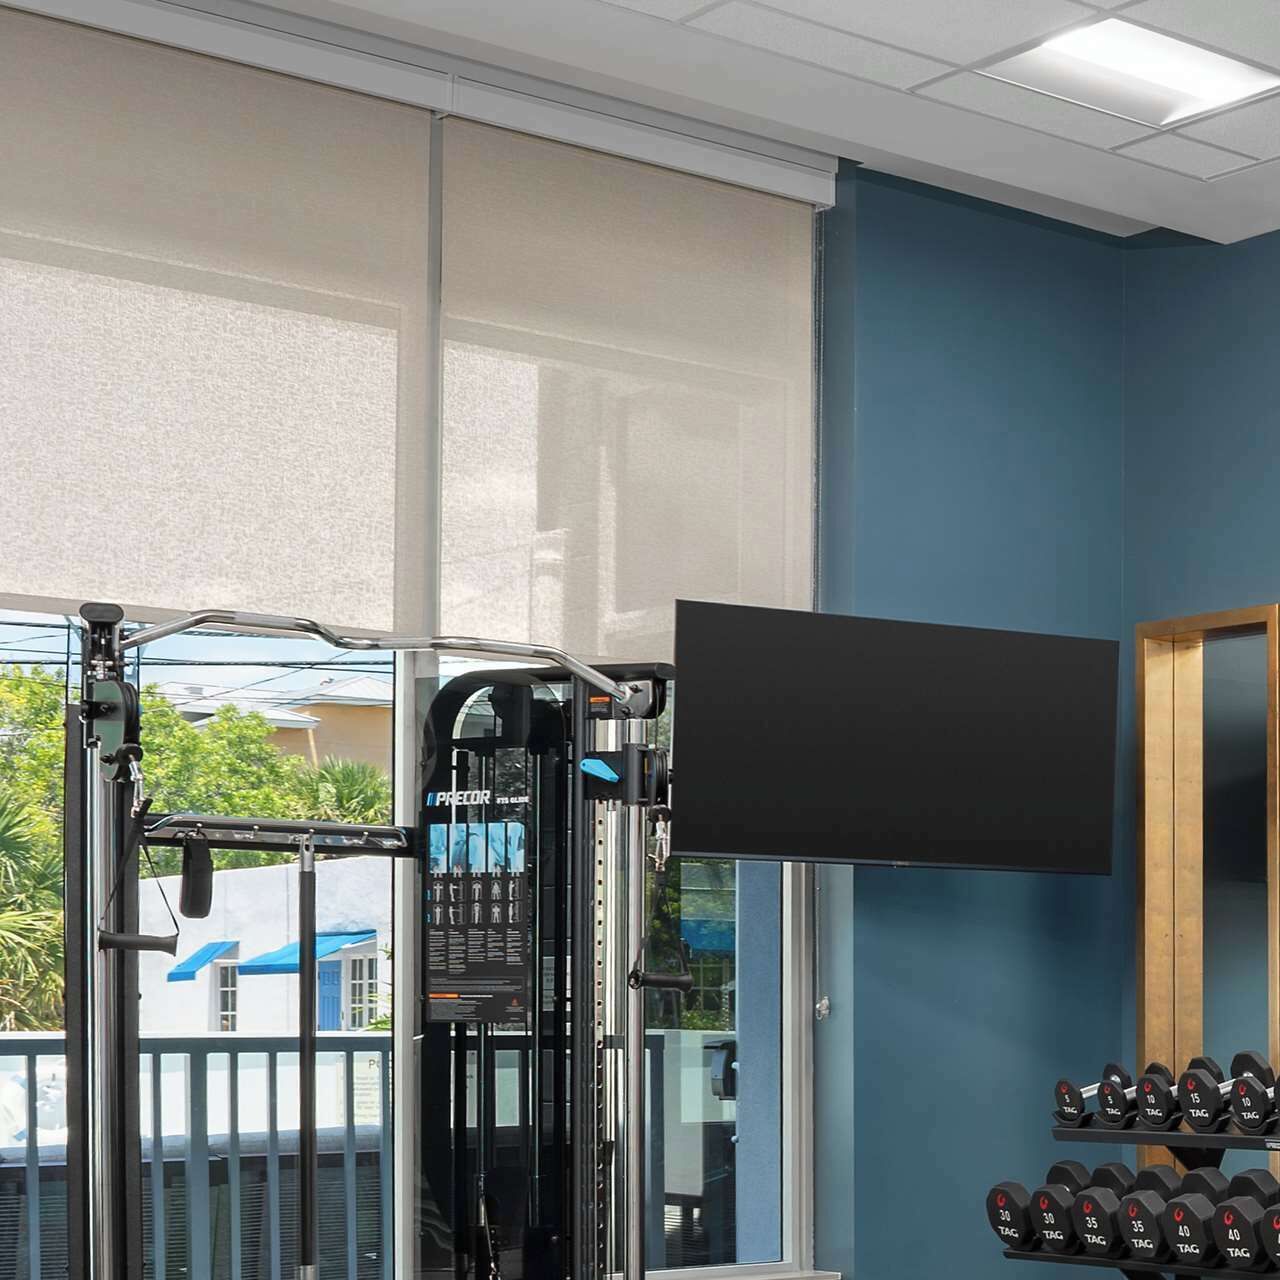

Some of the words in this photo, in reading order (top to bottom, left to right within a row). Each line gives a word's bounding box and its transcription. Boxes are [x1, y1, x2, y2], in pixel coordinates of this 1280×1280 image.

[436, 790, 490, 806] PRECOR
[1190, 1093, 1200, 1103] 15
[1242, 1097, 1251, 1107] 10
[1063, 1106, 1078, 1114] TAG
[1145, 1108, 1162, 1116] TAG
[1189, 1109, 1209, 1118] TAG
[1241, 1111, 1259, 1120] TAG
[999, 1209, 1011, 1221] 30
[1042, 1212, 1055, 1224] 30
[1085, 1216, 1098, 1229] 35
[1132, 1220, 1145, 1232] 35
[998, 1226, 1019, 1238] TAG
[1042, 1230, 1064, 1240] TAG
[1178, 1225, 1190, 1237] 40
[1228, 1229, 1240, 1241] 40
[1084, 1234, 1106, 1246] TAG
[1131, 1239, 1153, 1249] TAG
[1176, 1243, 1200, 1254] TAG
[1227, 1248, 1250, 1258] TAG
